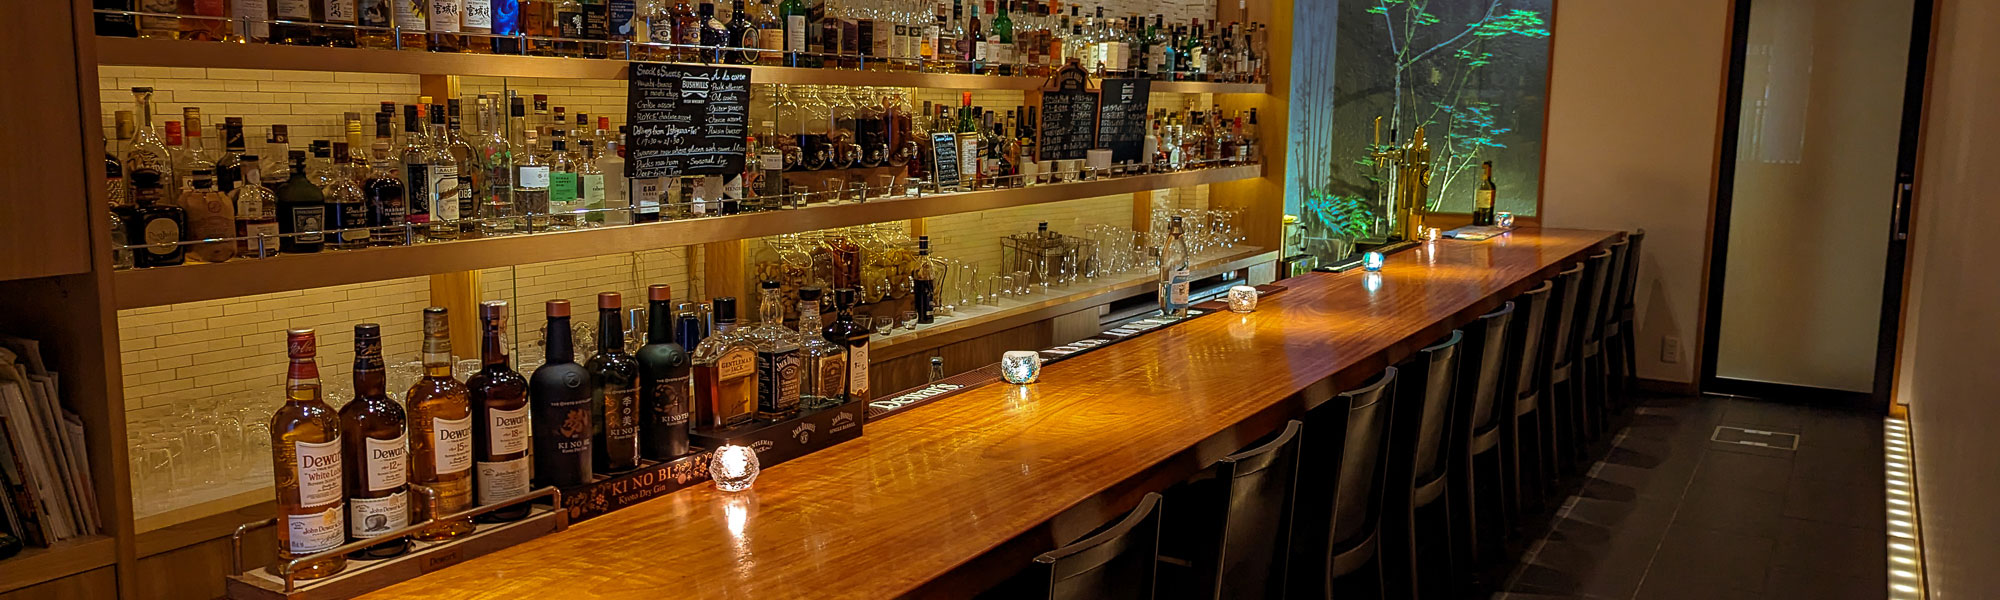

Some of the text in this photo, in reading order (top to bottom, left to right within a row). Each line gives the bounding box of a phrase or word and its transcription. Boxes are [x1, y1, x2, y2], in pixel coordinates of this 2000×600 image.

[682, 80, 709, 89] BUSHMILLS
[721, 357, 752, 369] GENTLEMAN
[622, 396, 633, 426] 季の美
[511, 429, 519, 437] 18
[457, 443, 465, 451] 15
[389, 461, 398, 469] 12
[612, 480, 628, 497] KI
[632, 472, 654, 490] NO
[618, 484, 666, 505] Kyoto Dry Gin
